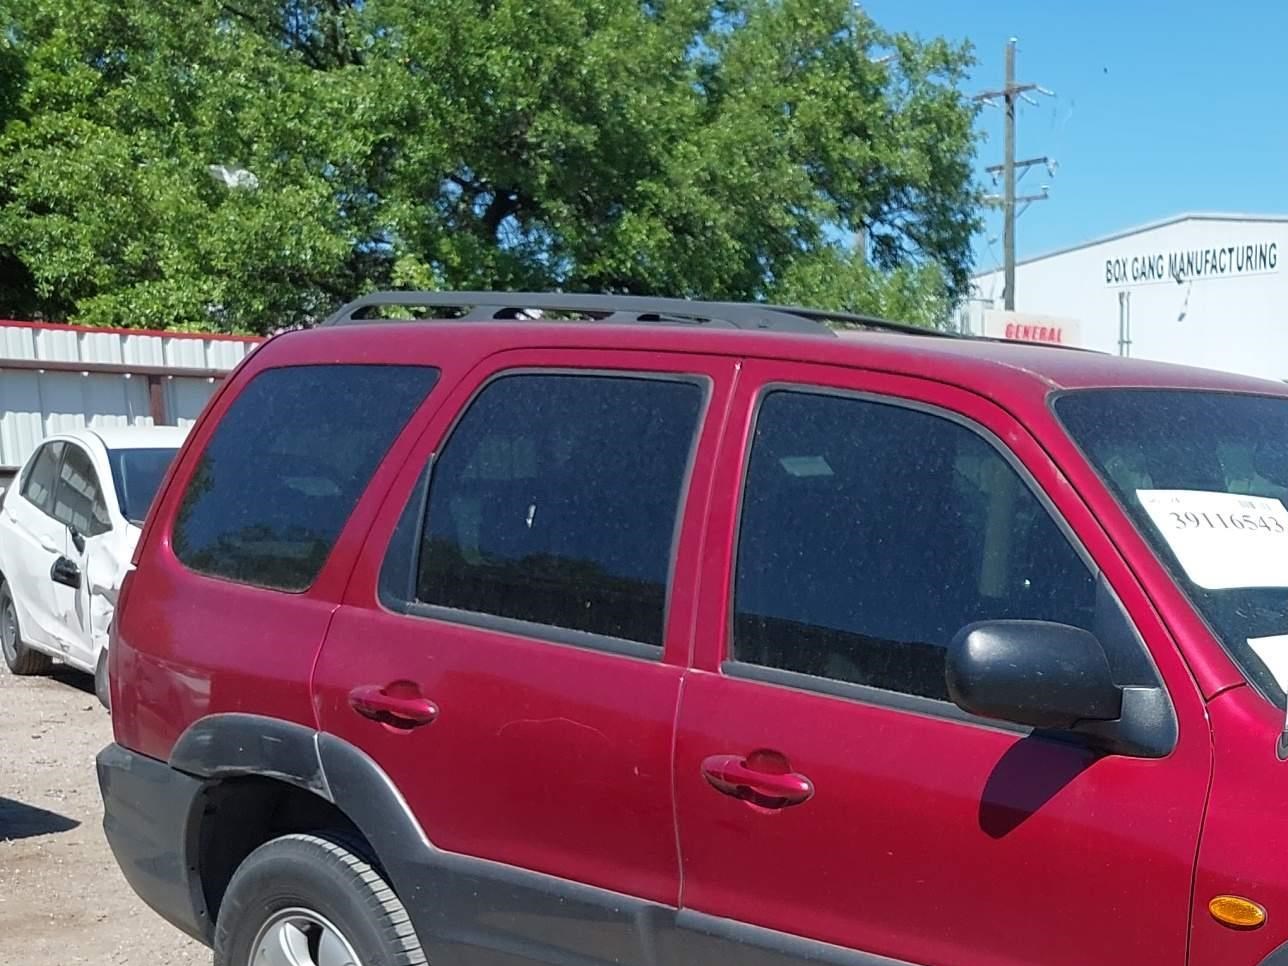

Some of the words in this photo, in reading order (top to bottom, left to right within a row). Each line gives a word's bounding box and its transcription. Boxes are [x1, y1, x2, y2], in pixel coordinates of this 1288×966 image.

[1105, 258, 1129, 284] BOX
[1131, 253, 1165, 282] GANG
[1168, 242, 1277, 278] MANUFACTURING
[1005, 322, 1063, 343] GENERAL
[1169, 511, 1284, 533] 39116543
